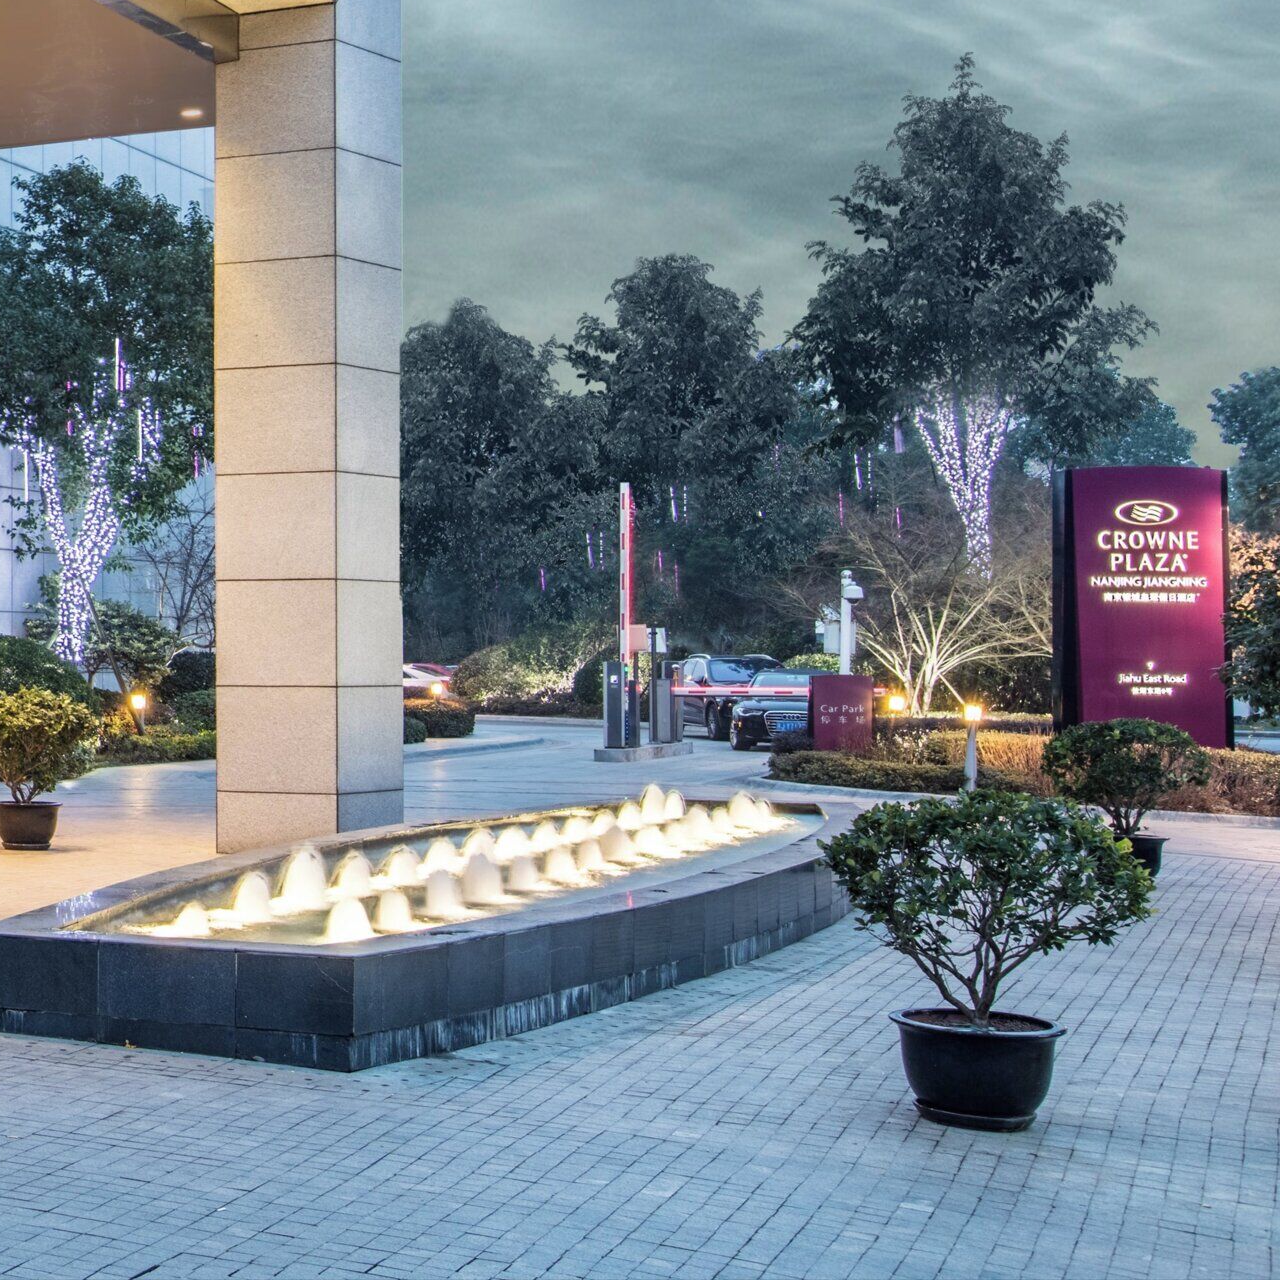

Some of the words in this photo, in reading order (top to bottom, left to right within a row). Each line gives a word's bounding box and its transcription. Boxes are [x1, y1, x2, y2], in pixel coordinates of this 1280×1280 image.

[1097, 530, 1200, 550] CROWNE
[1110, 552, 1187, 572] PLAZA
[1090, 576, 1141, 588] NANJING
[1143, 576, 1207, 588] JIANGNING
[1146, 661, 1155, 671] 9
[1118, 673, 1141, 684] Jiahu
[1143, 673, 1162, 683] East
[1163, 673, 1187, 683] Road
[820, 704, 838, 713] Car
[842, 704, 864, 713] Park
